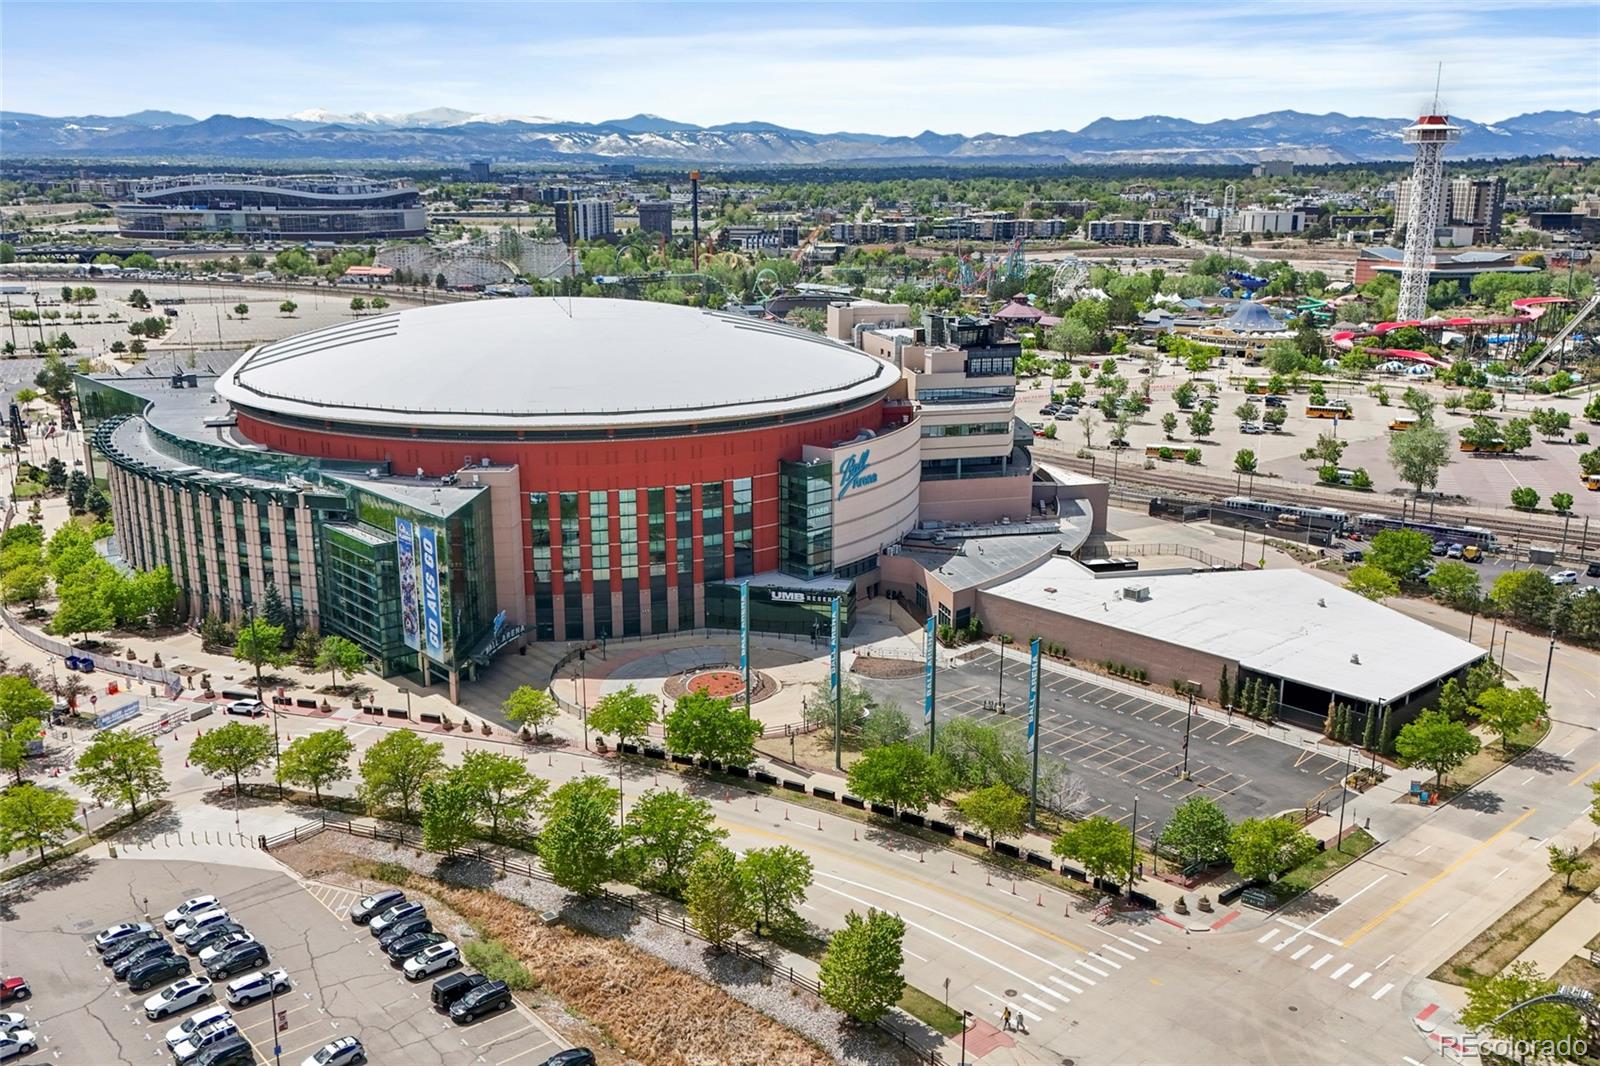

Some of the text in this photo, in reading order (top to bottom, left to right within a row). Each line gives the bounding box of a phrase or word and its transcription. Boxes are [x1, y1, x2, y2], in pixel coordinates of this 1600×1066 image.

[423, 537, 440, 649] GO AVS GO
[771, 590, 805, 602] UMB
[502, 624, 526, 641] ARENA
[926, 630, 934, 667] ARENA
[1028, 655, 1038, 723] BALL ARENA
